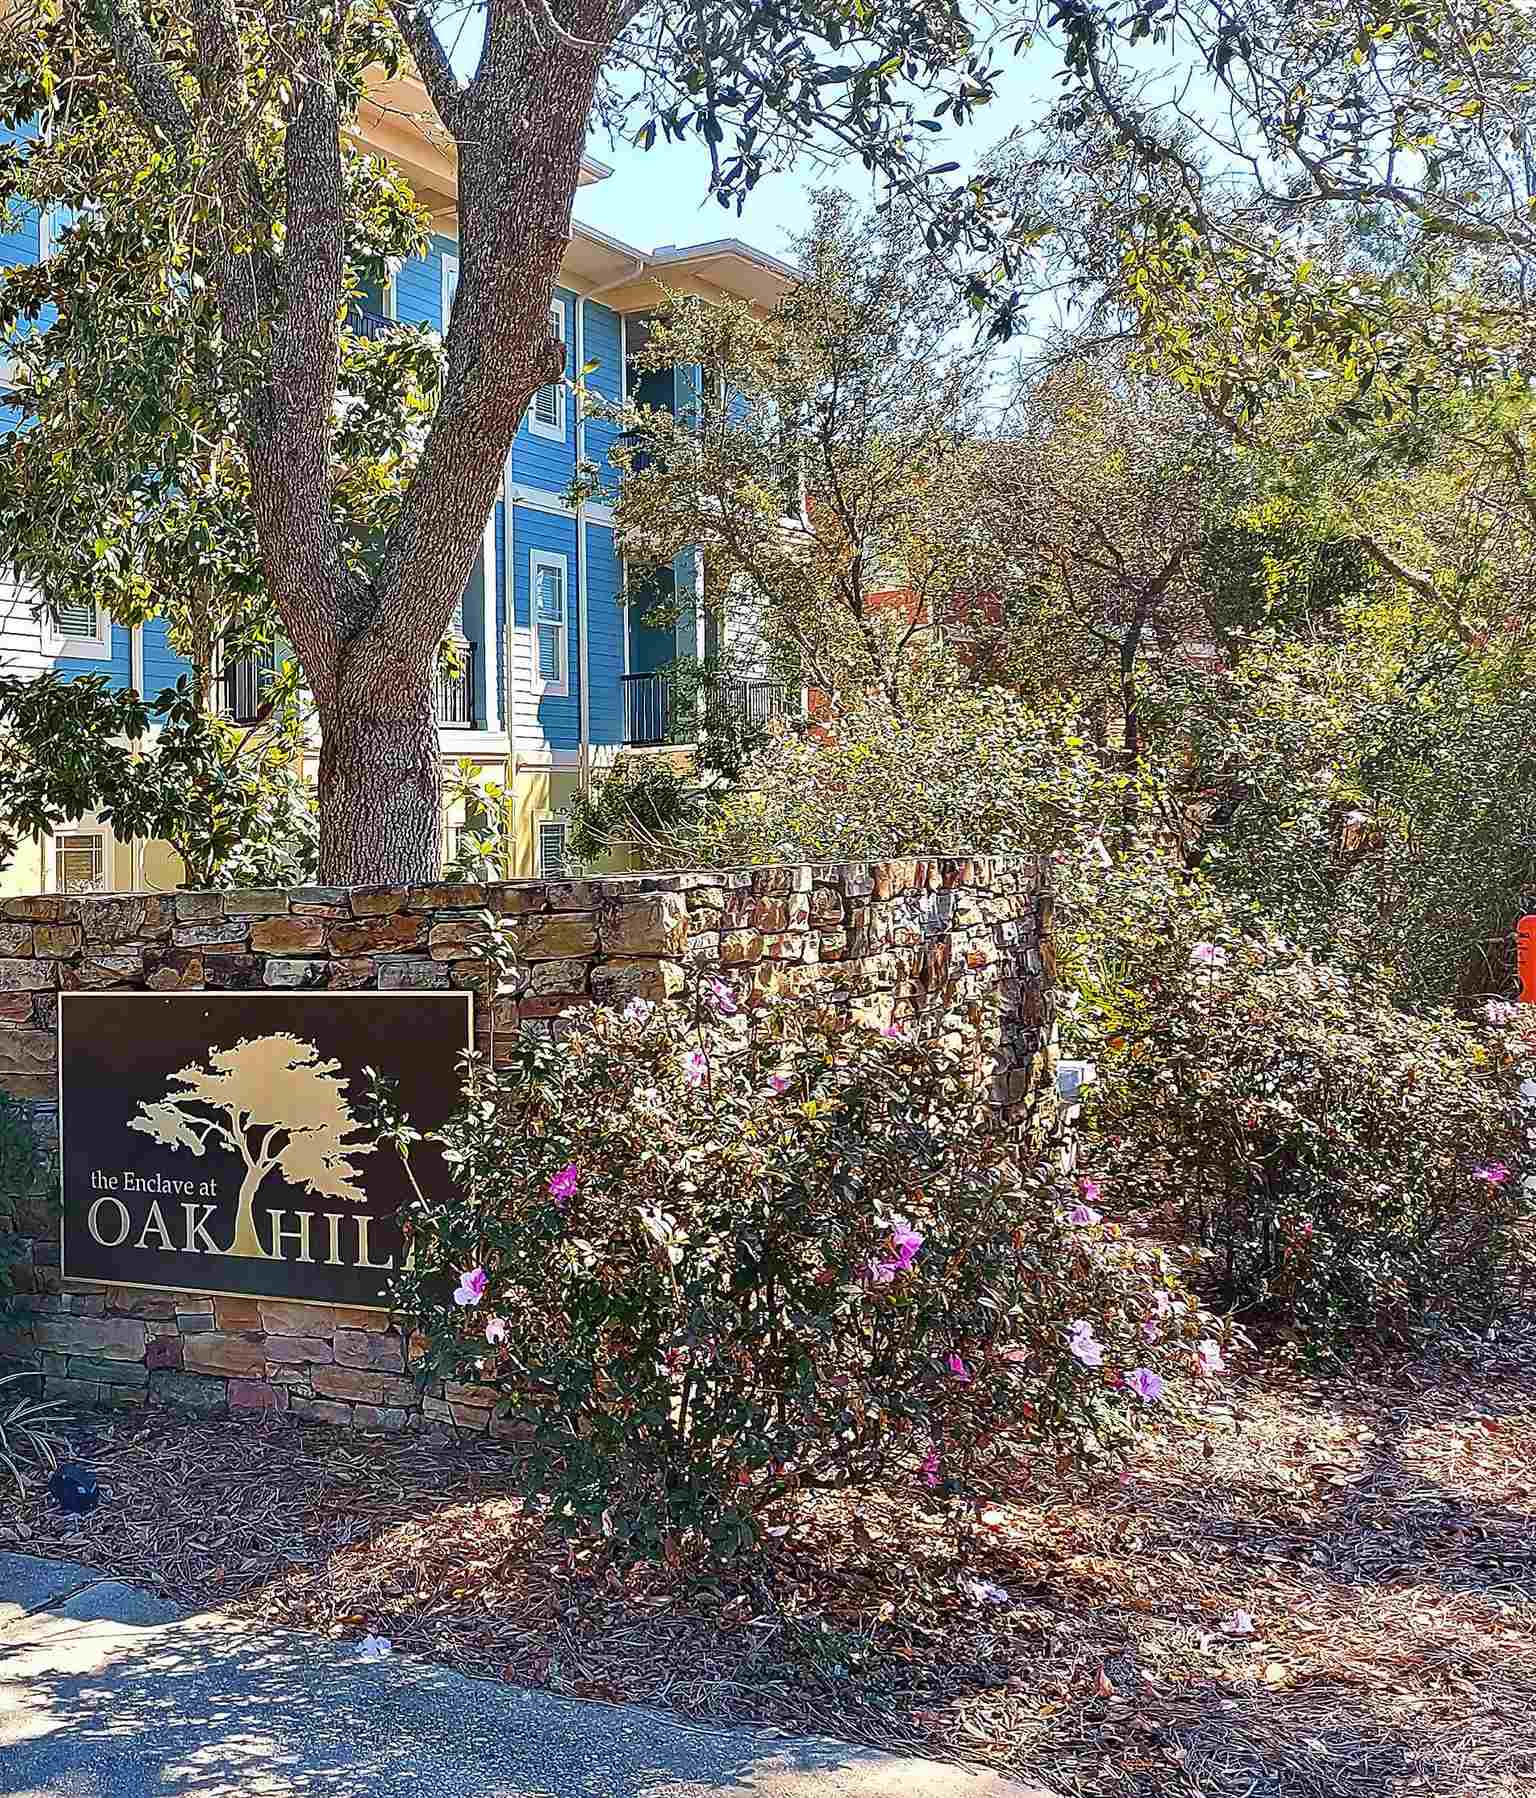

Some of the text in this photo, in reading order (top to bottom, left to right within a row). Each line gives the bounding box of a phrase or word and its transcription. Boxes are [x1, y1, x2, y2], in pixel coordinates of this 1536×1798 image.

[91, 1169, 217, 1197] the Enclave at
[87, 1196, 416, 1272] OAK HIL
